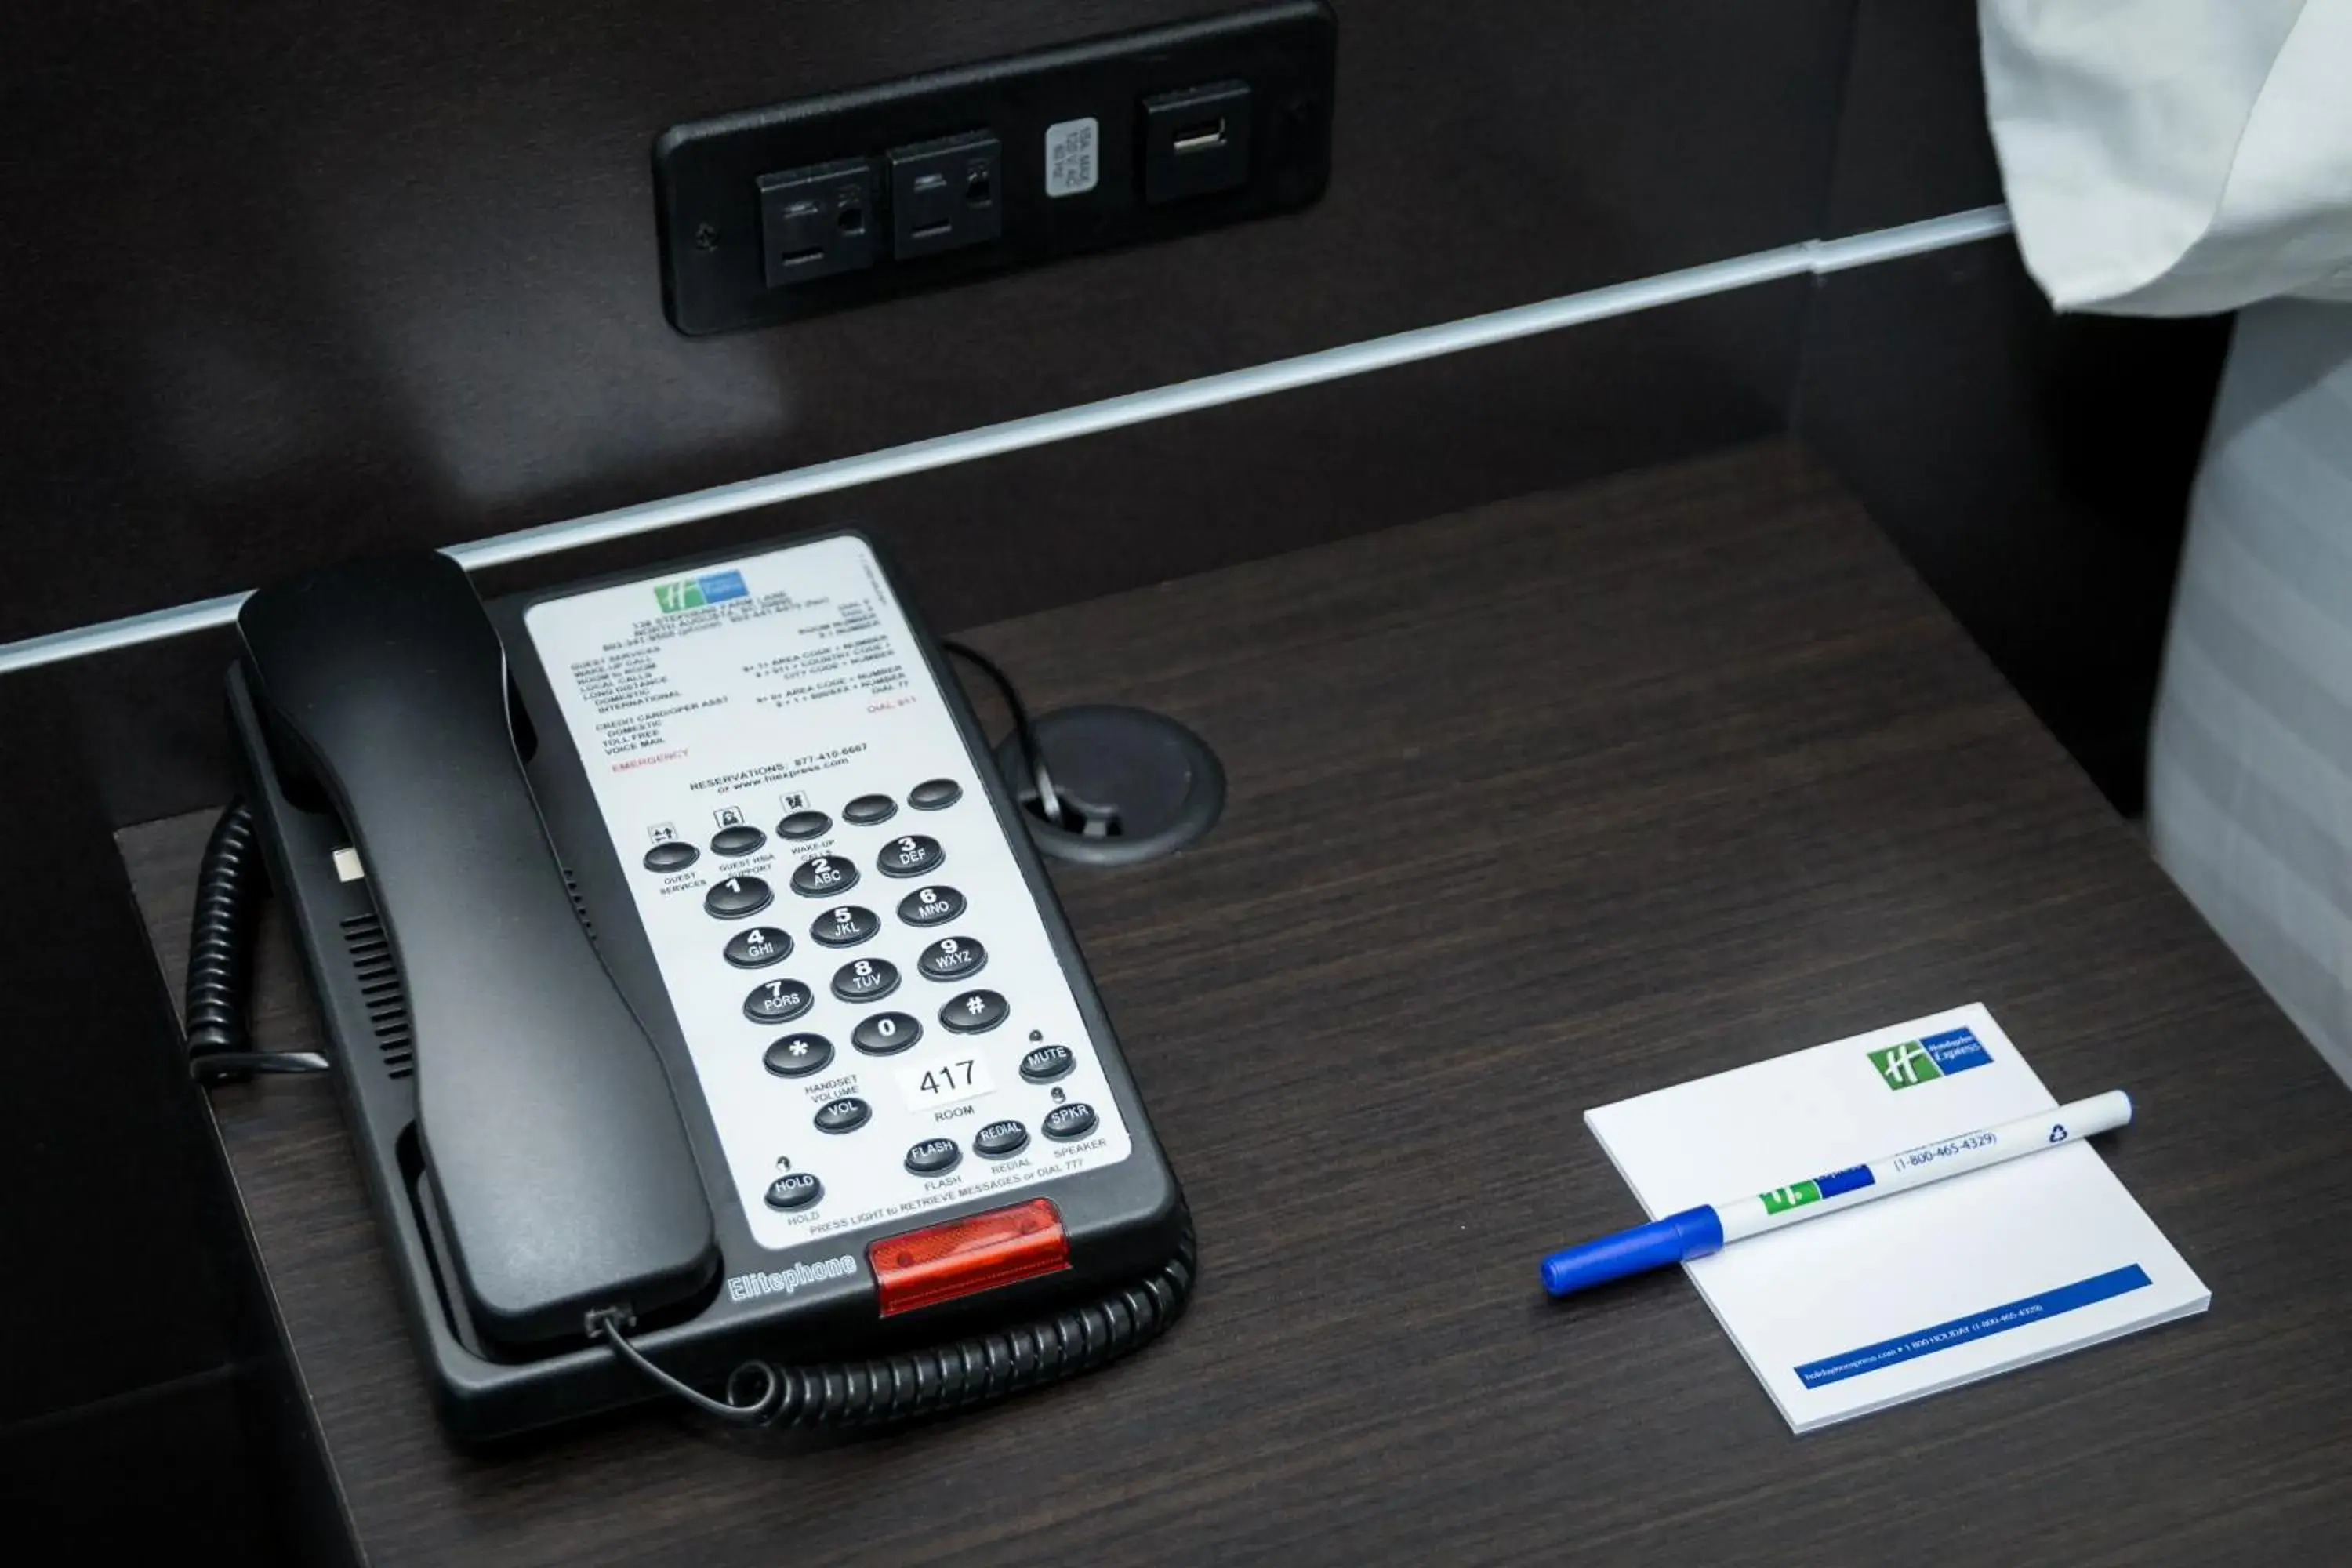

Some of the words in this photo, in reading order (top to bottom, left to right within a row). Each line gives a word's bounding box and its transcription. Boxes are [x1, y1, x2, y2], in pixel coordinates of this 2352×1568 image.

[836, 620, 880, 634] NUMBER
[570, 658, 606, 671] GUEST
[608, 646, 661, 663] SERVICES
[771, 655, 800, 666] AREA
[802, 648, 832, 659] CODE
[843, 634, 888, 650] NUMBER
[800, 652, 850, 667] COUNTRY
[852, 644, 883, 655] CODE
[625, 655, 652, 666] CALL
[783, 670, 807, 681] CITY
[808, 662, 839, 673] CODE
[850, 649, 895, 665] NUMBER
[576, 673, 610, 686] ROOM
[624, 662, 657, 675] ROOM
[579, 679, 615, 694] LOCAL
[617, 672, 652, 684] CALLS
[786, 685, 815, 697] AREA
[816, 677, 845, 690] CODE
[857, 665, 902, 680] NUMBER
[861, 673, 906, 688] NUMBER
[583, 688, 615, 702] LONG
[615, 676, 667, 695] DISTANCE
[594, 689, 650, 707] DOMESTIC
[871, 684, 894, 695] DIAL
[598, 691, 680, 713] INTERNATIONAL
[866, 702, 895, 713] DIAL
[595, 717, 634, 731] CREDIT
[607, 719, 662, 738] DOMESTIC
[602, 736, 630, 748] TOLL
[631, 729, 659, 741] FREE
[604, 742, 637, 756] VOICE
[640, 737, 664, 748] MAIL
[612, 749, 688, 772] EMERGENCY
[898, 837, 916, 853] 3
[718, 858, 750, 872] GUEST
[801, 850, 832, 862] CALLS
[899, 848, 926, 866] DEF
[728, 863, 771, 881] SUPPORT
[811, 858, 832, 874] 2
[659, 879, 707, 895] SERVICES
[664, 871, 695, 885] GUEST
[725, 878, 741, 893] 1
[815, 869, 842, 887] ABC
[920, 888, 937, 904] 6
[834, 907, 852, 924] 5
[918, 900, 949, 919] MNO
[747, 929, 765, 944] 4
[834, 921, 861, 939] JKL
[748, 942, 774, 960] GHI
[940, 938, 962, 957] 9
[936, 950, 972, 969] WXYZ
[854, 960, 873, 979] 8
[765, 981, 788, 1000] 7
[852, 972, 881, 992] TUV
[877, 1018, 896, 1036] 0
[1027, 1047, 1067, 1066] MUTE
[1931, 1040, 1985, 1062] Express
[805, 1075, 856, 1094] HANDSET
[920, 1060, 974, 1093] 417
[811, 1085, 858, 1104] VOLUME
[827, 1100, 858, 1116] VOL
[934, 1105, 975, 1122] ROOM
[1051, 1105, 1088, 1125] SPKR
[979, 1122, 1022, 1142] REDIAL
[912, 1142, 953, 1161] FLASH
[1054, 1139, 1106, 1158] SPEAKER
[1893, 1132, 1996, 1171] (1-800-465-4329)
[990, 1158, 1032, 1174] REDIAL
[775, 1175, 815, 1193] HOLD
[924, 1174, 962, 1192] FLASH
[809, 1218, 849, 1236] PRESS
[850, 1208, 884, 1225] LIGHT
[885, 1207, 898, 1217] to
[900, 1192, 955, 1211] RETRIEVE
[958, 1175, 1021, 1196] MESSAGES
[1023, 1172, 1035, 1181] or
[1036, 1164, 1063, 1178] DIAL
[1065, 1158, 1083, 1171] 777
[787, 1210, 821, 1226] HOLD
[728, 1254, 857, 1303] Elitephone
[1929, 1327, 1969, 1343] HOLIDAY
